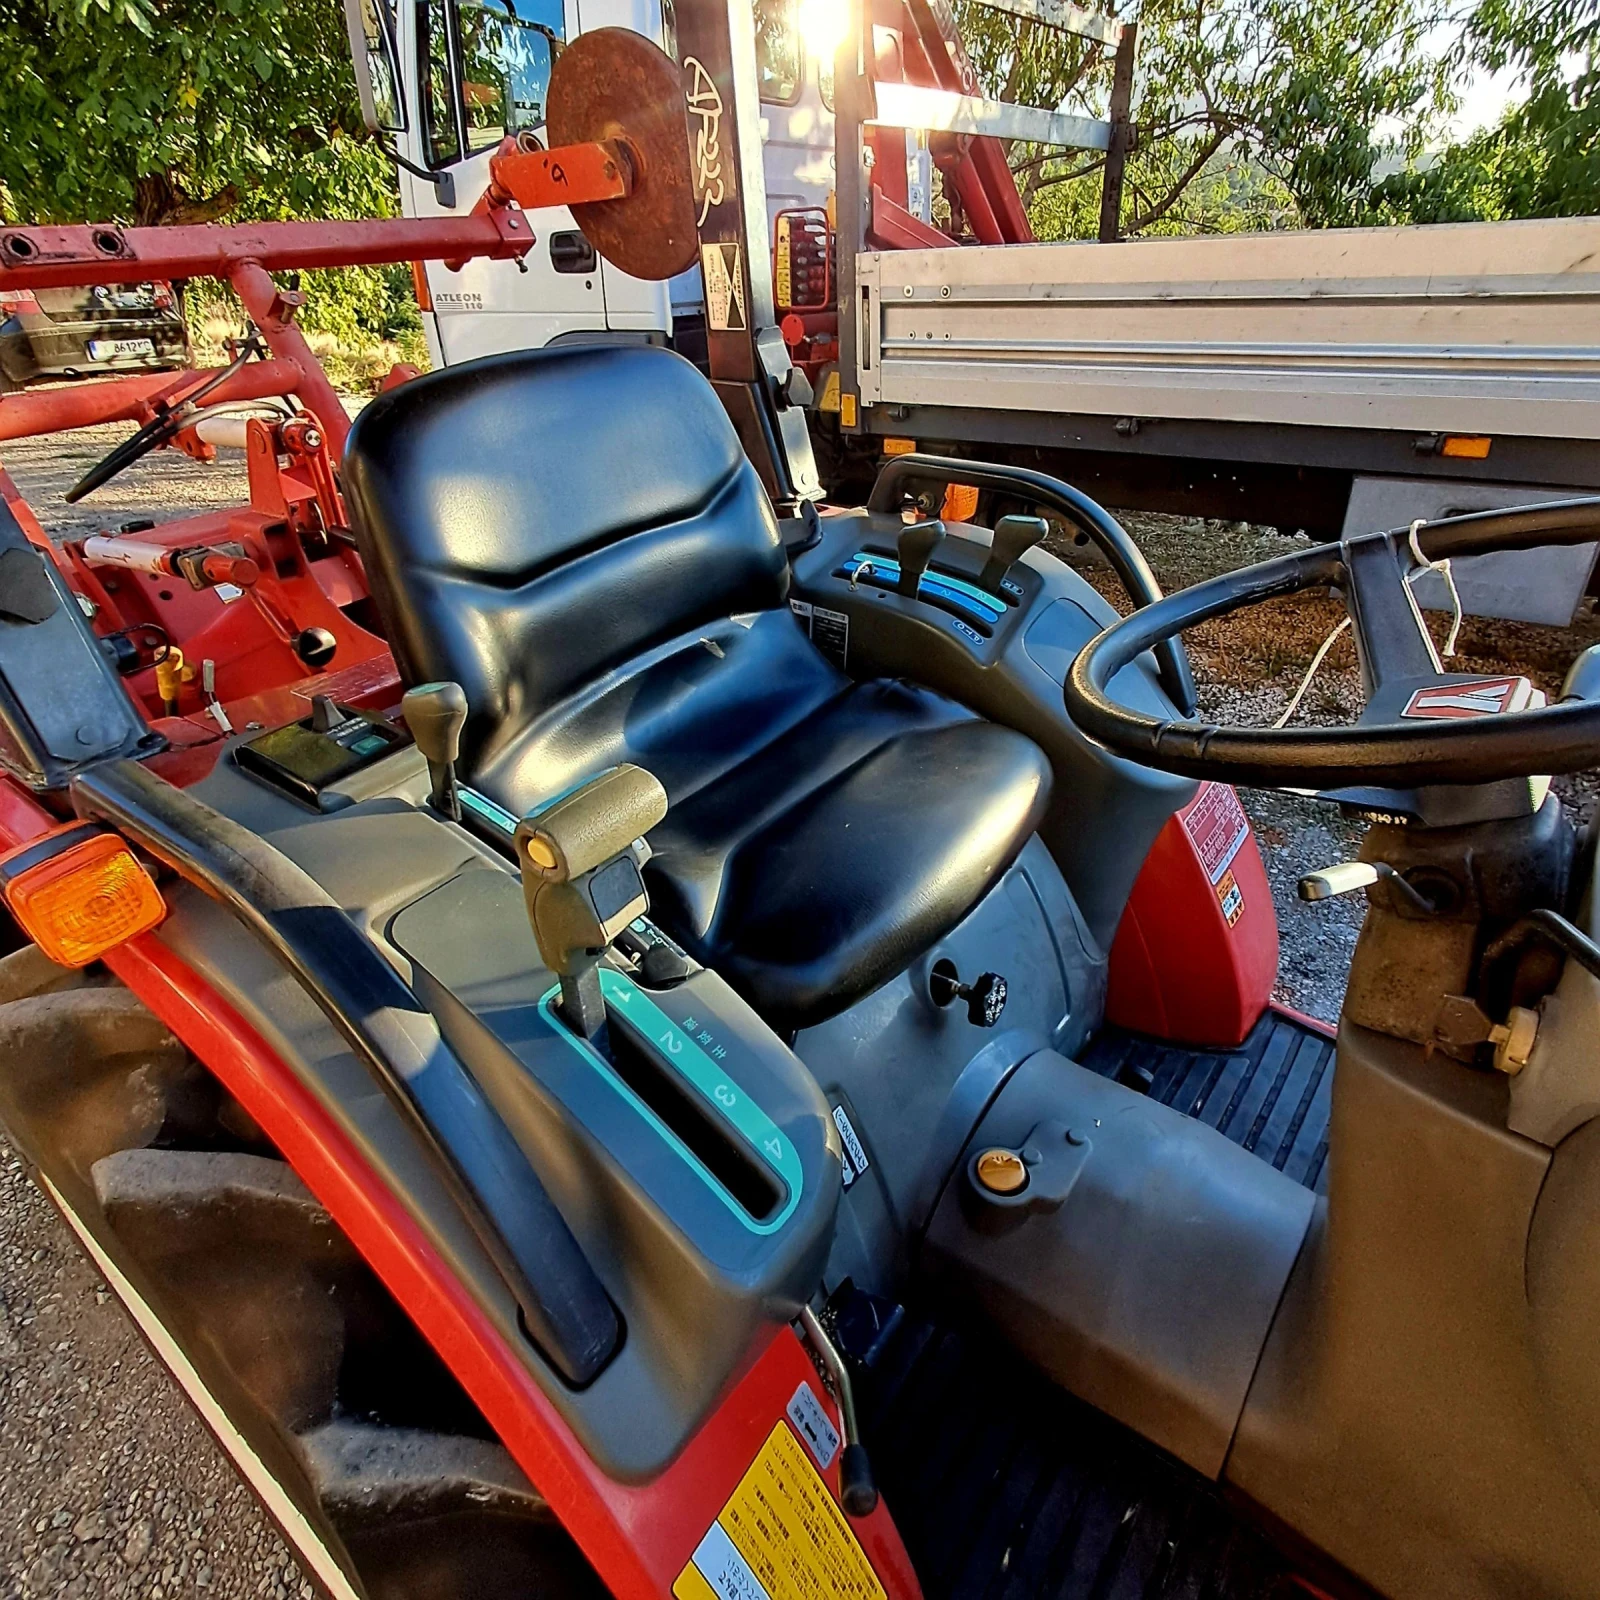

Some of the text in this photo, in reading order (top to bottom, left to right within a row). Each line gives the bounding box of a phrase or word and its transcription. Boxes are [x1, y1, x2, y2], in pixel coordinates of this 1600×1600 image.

[435, 293, 482, 302] ATLEON
[465, 302, 483, 310] 110
[611, 984, 783, 1160] 1 2 3 4
